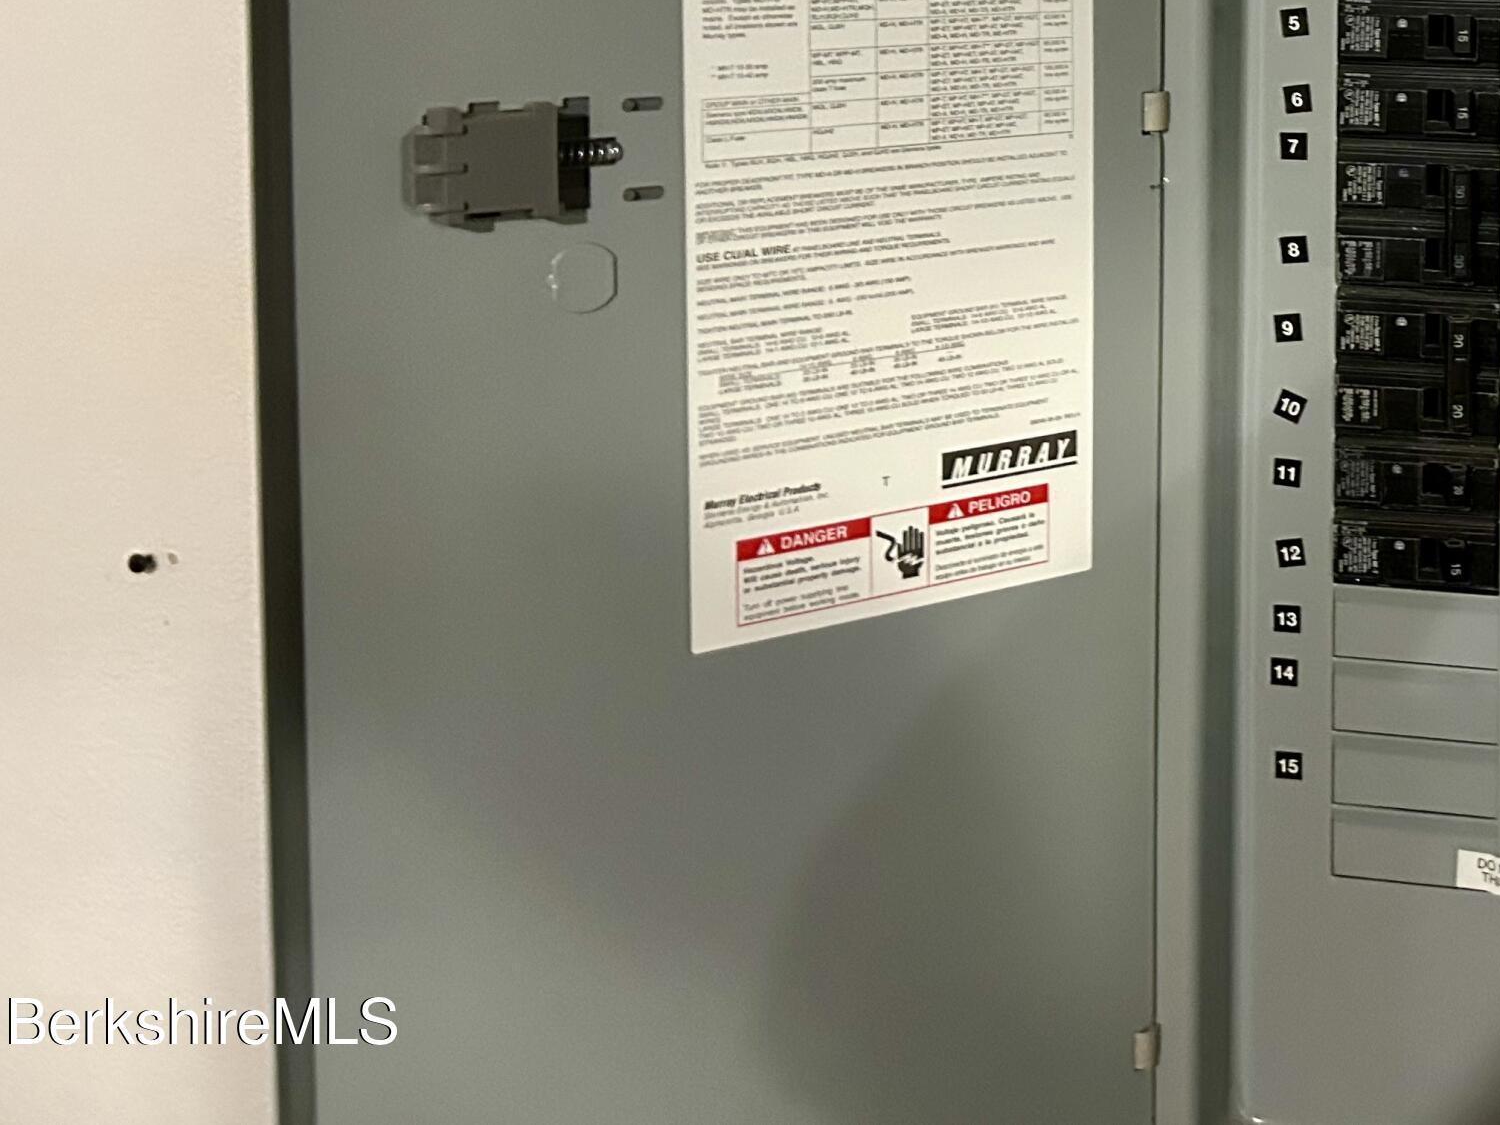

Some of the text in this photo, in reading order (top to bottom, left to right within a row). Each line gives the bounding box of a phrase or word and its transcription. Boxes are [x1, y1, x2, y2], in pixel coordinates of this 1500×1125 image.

[1287, 14, 1301, 32] 5
[1290, 91, 1304, 108] 6
[1286, 138, 1299, 154] 7
[696, 252, 719, 264] USE
[761, 244, 791, 256] WIRE
[1286, 241, 1301, 258] 8
[1281, 320, 1295, 337] 9
[1452, 333, 1465, 348] 20
[1280, 397, 1302, 418] 10
[1452, 404, 1464, 419] 20
[951, 437, 1071, 480] MURRAY
[1276, 465, 1296, 482] 11
[968, 491, 1031, 514] PELIGRO
[780, 525, 848, 550] DANGER
[1279, 545, 1302, 563] 12
[1276, 611, 1298, 627] 13
[1273, 664, 1295, 681] 14
[1278, 758, 1299, 774] 15
[1477, 857, 1496, 871] DO
